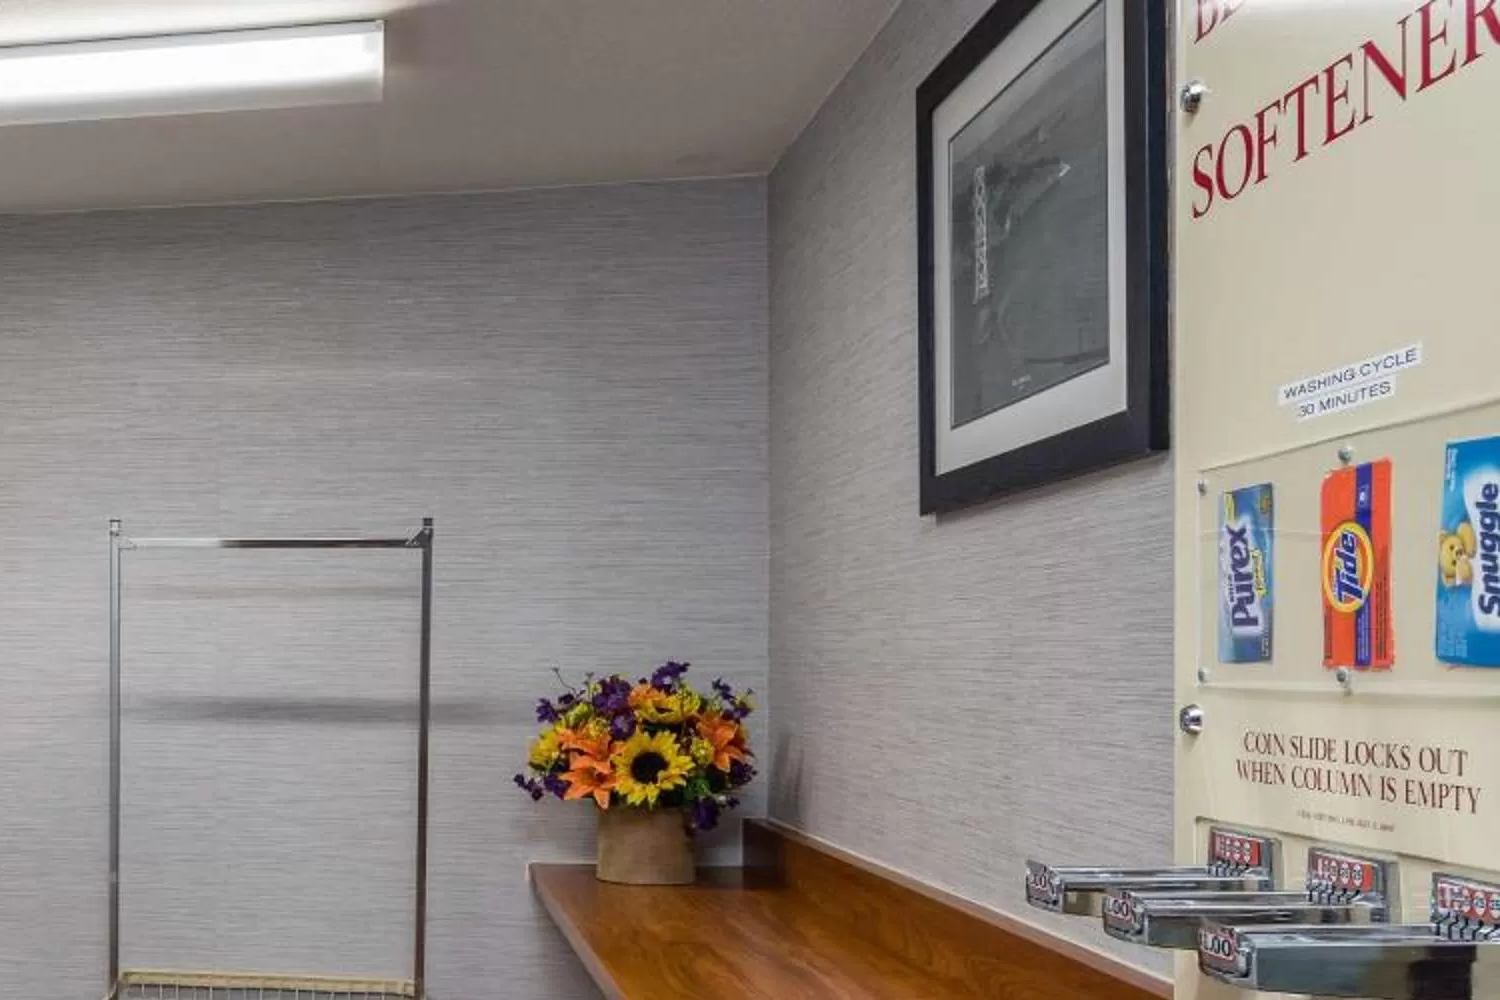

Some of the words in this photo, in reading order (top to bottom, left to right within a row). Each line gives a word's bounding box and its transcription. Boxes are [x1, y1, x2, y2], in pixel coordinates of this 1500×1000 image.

[1284, 367, 1355, 399] WASHING
[1359, 347, 1418, 377] CYCLE
[1298, 403, 1315, 417] 30
[1318, 381, 1391, 413] MINUTES
[1226, 524, 1258, 626] Purex
[1335, 532, 1363, 603] Tide
[1476, 482, 1500, 617] Snuggle
[1243, 731, 1285, 757] COIN
[1289, 735, 1337, 763] SLIDE
[1344, 740, 1411, 771] LOCKS
[1419, 746, 1469, 777] OUT
[1236, 759, 1286, 785] WHEN
[1291, 765, 1373, 798] COLUMN
[1380, 776, 1398, 802] IS
[1404, 780, 1482, 814] EMPTY
